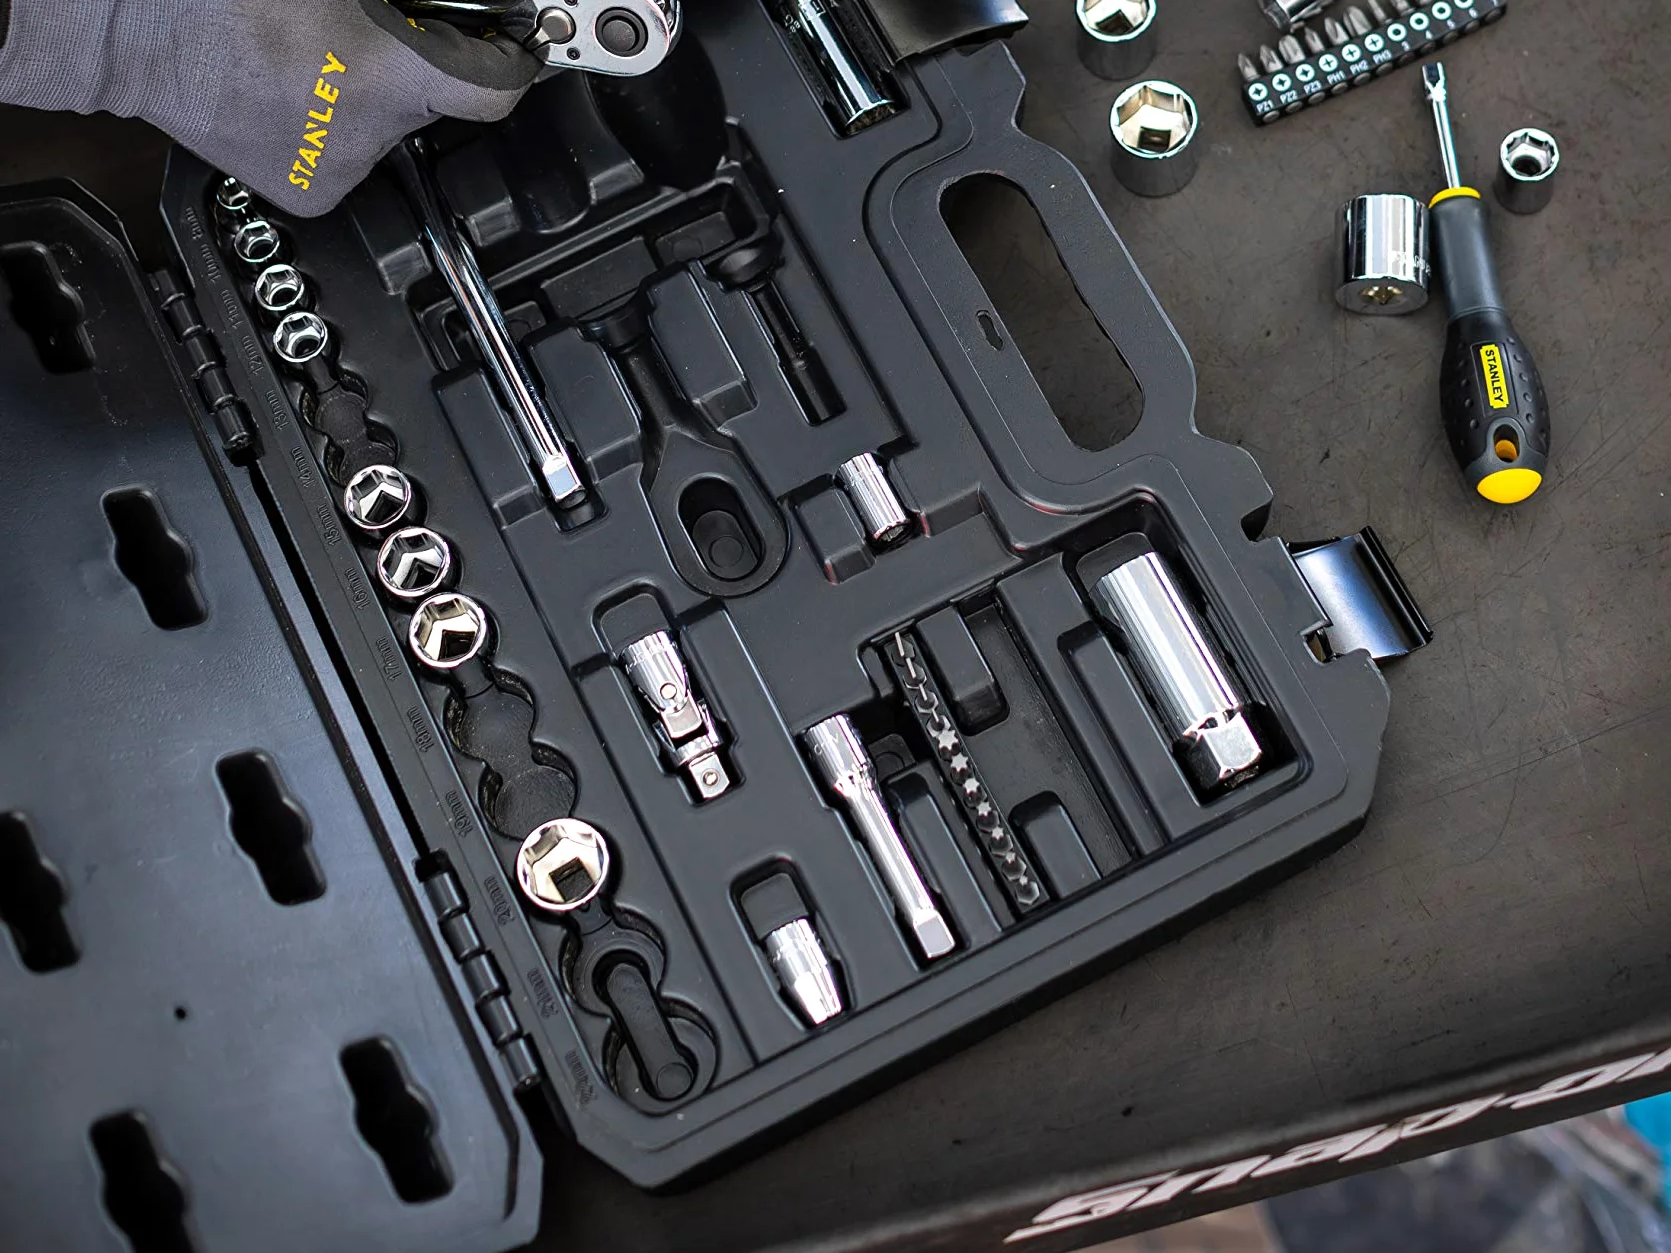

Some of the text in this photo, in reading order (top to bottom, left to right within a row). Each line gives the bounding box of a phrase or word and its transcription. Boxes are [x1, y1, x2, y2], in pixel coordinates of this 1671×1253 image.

[1280, 90, 1298, 104] PZ2
[1327, 70, 1346, 85] PH1
[1350, 59, 1369, 75] PH2
[289, 51, 346, 190] STANLEY
[242, 335, 264, 376] 12mm
[1485, 349, 1504, 403] STANLEY
[266, 389, 289, 431] 13mm
[291, 447, 316, 488] 14mm
[318, 504, 341, 546] 15mm
[345, 567, 371, 610] 16mm
[375, 636, 402, 681] 17mm
[407, 707, 434, 753] 18mm
[446, 791, 474, 839] 19mm
